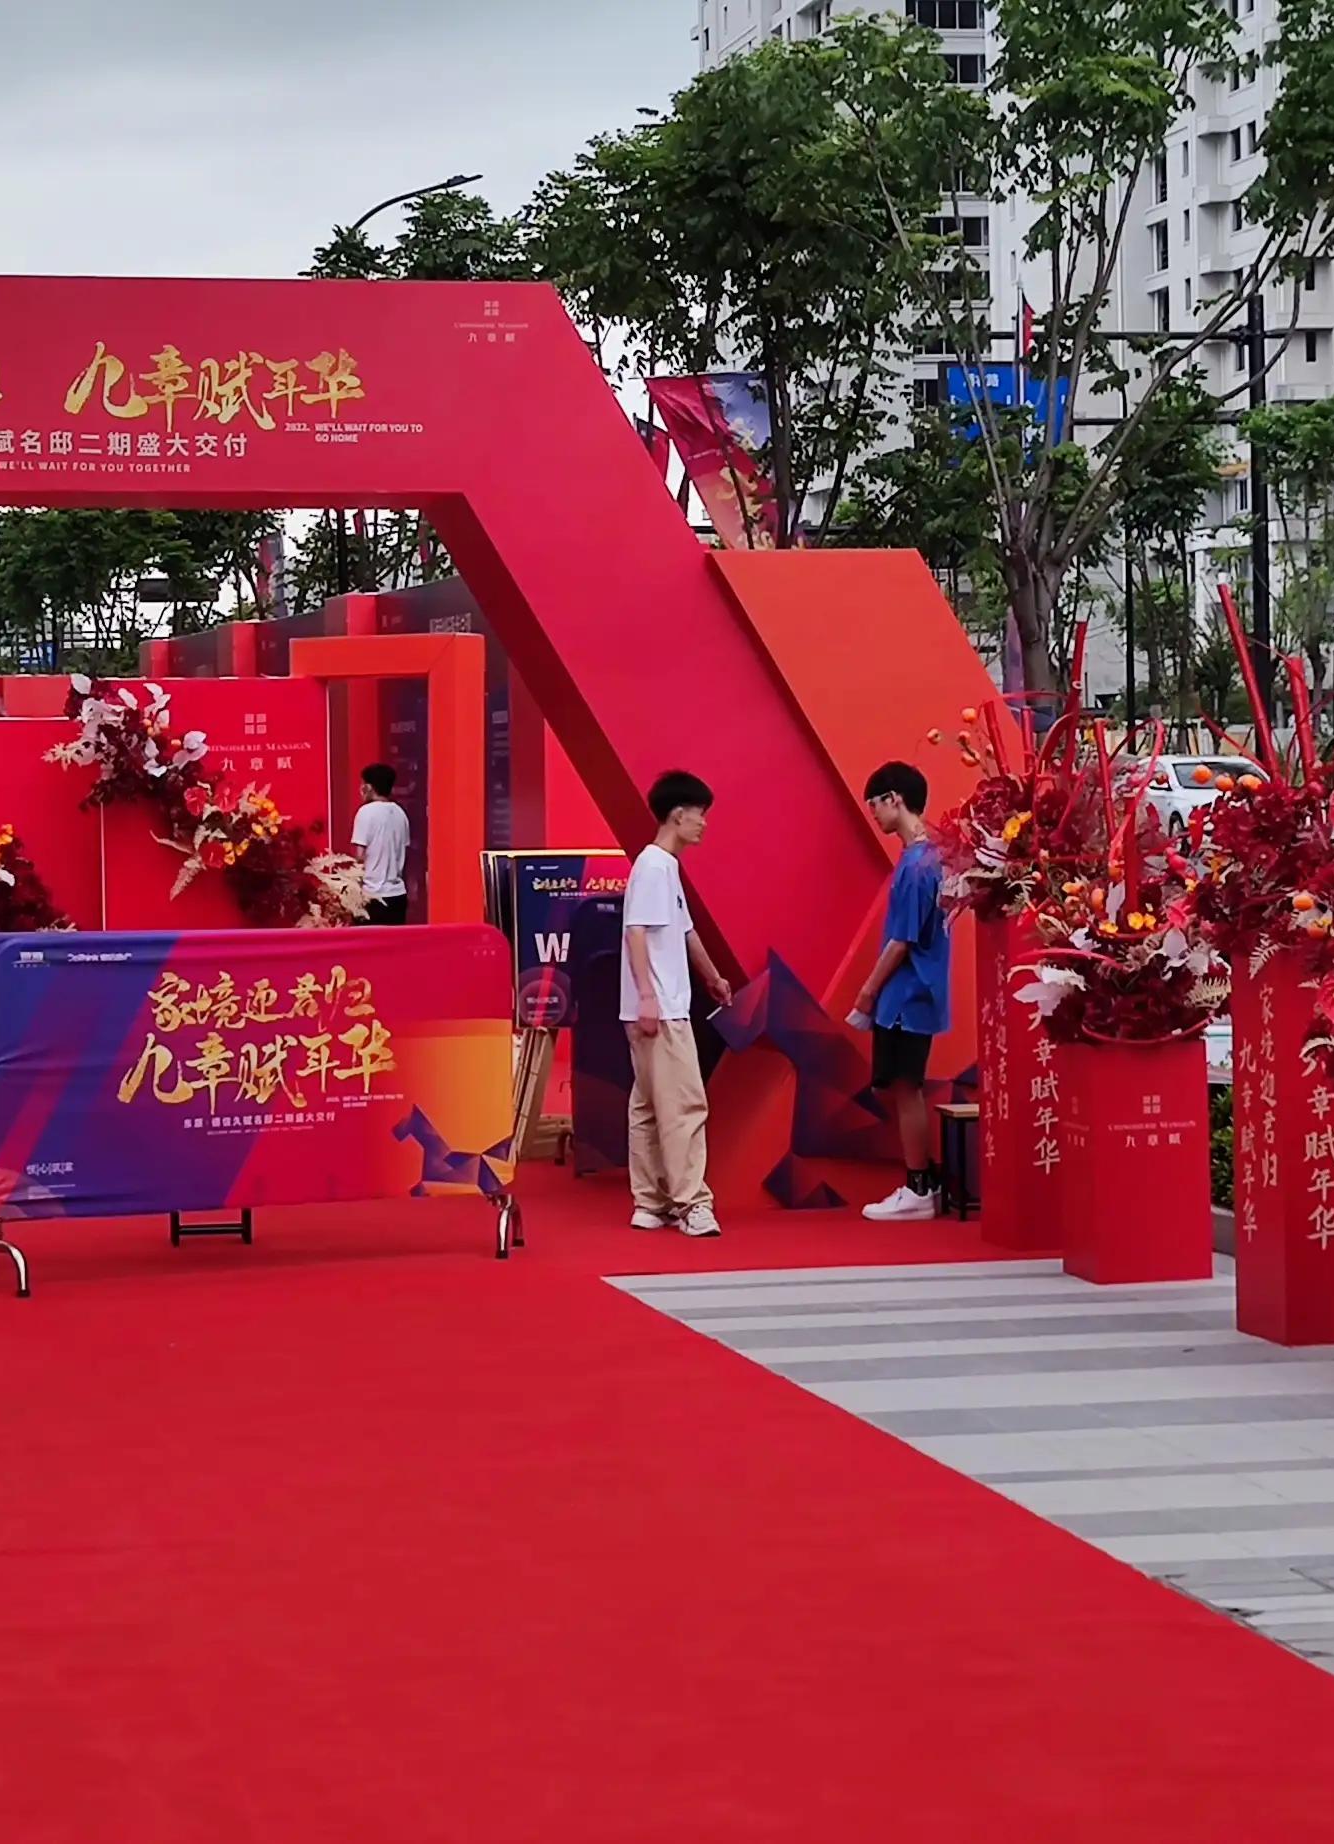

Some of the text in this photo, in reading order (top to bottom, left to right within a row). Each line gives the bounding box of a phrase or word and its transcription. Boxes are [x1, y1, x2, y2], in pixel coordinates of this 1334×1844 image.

[410, 424, 423, 432] TO
[38, 462, 68, 471] WAIT
[72, 462, 96, 472] FOR
[100, 463, 124, 473] YOU
[129, 463, 191, 473] TOGETHER
